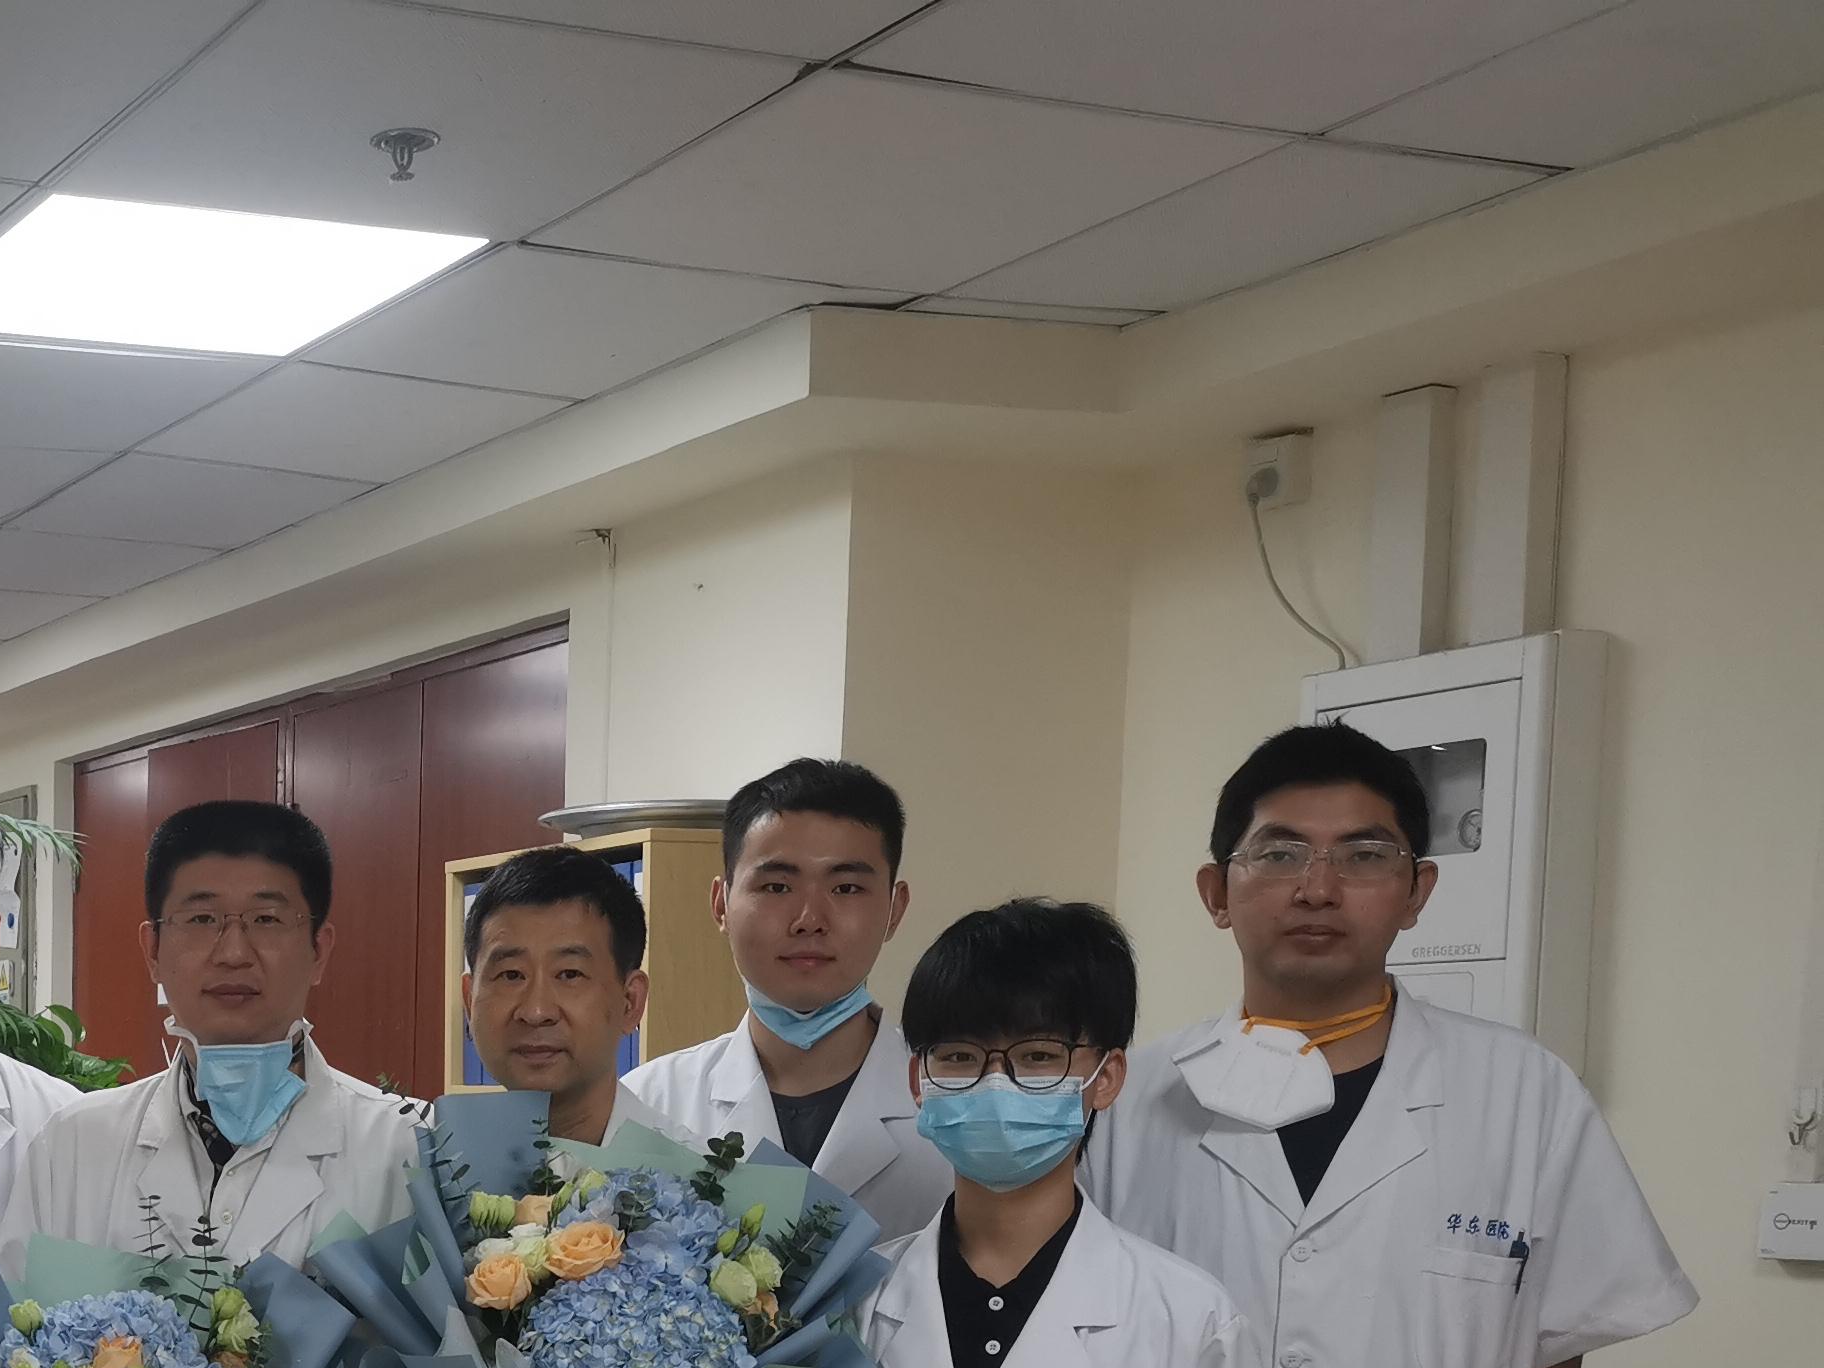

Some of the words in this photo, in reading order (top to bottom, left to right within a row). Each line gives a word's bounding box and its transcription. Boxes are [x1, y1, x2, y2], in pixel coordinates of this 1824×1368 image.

[1411, 943, 1482, 958] GREGGERSEN
[1446, 1213, 1510, 1240] 华东医院
